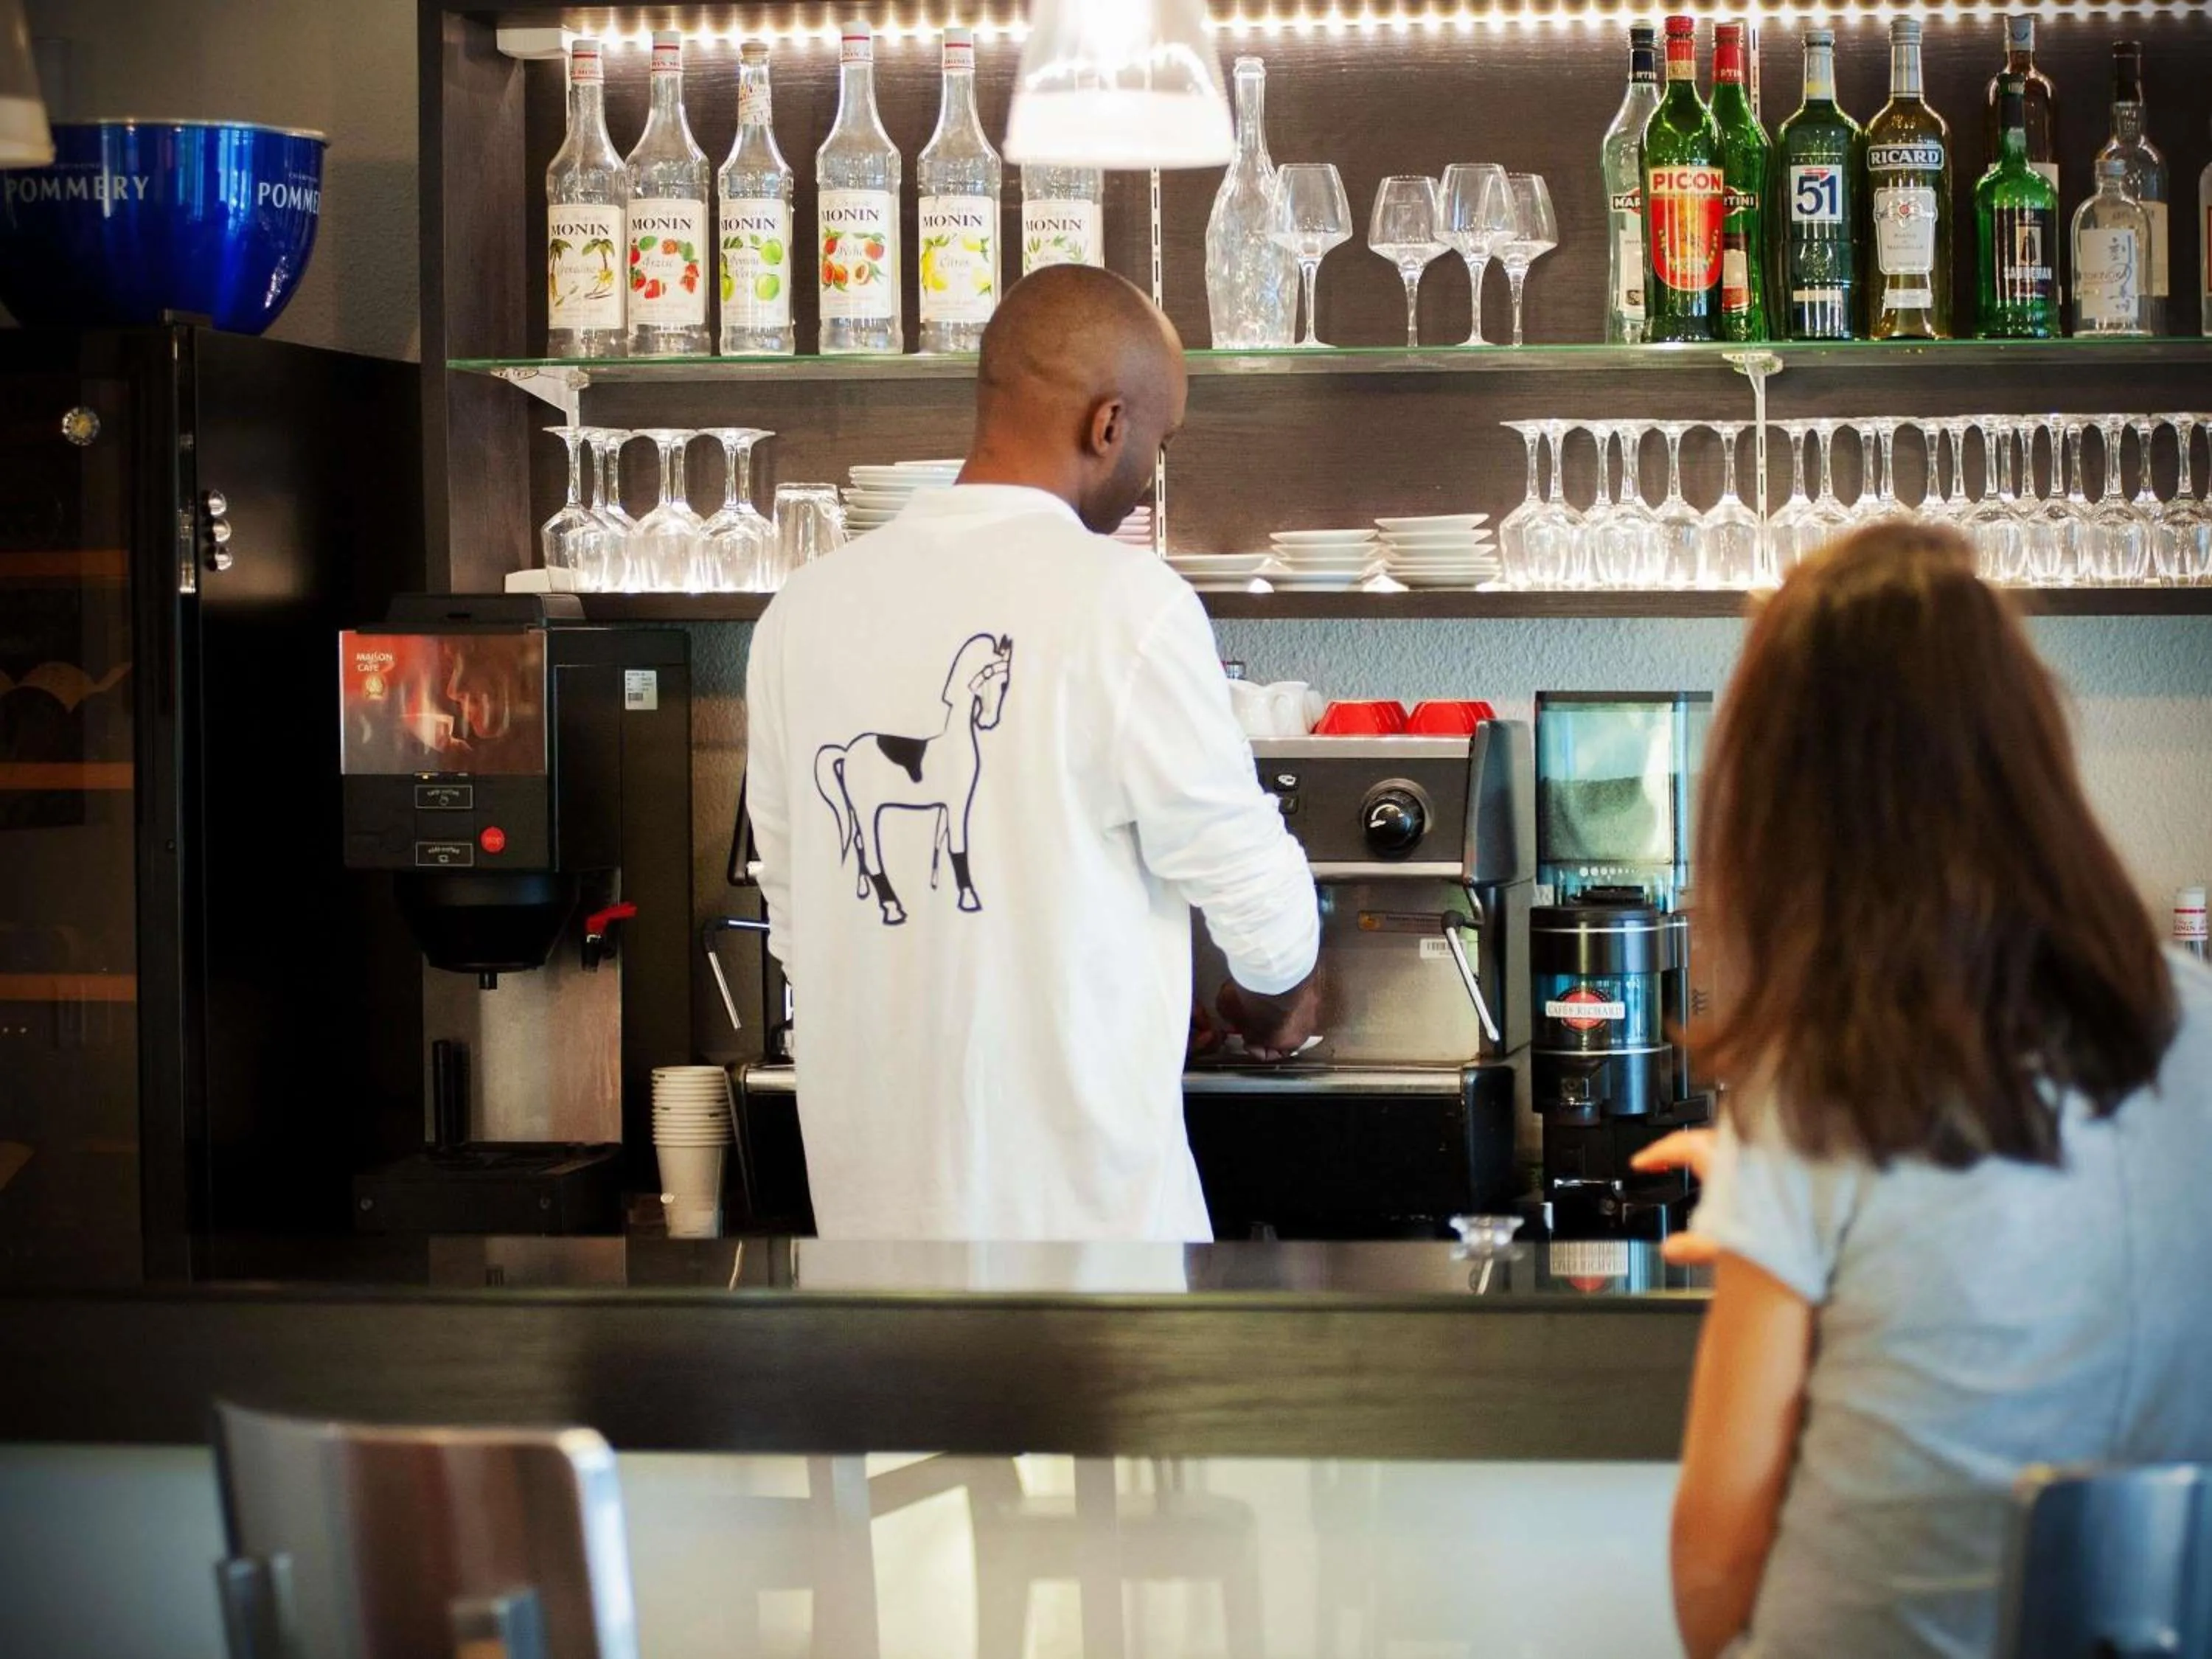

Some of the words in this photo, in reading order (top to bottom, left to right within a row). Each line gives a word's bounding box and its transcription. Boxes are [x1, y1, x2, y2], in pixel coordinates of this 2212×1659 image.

[1871, 150, 1939, 164] RICARD
[1652, 173, 1722, 190] PICON
[4, 176, 149, 203] POMMERY
[1796, 175, 1837, 215] 51
[821, 209, 879, 221] MONIN
[923, 215, 982, 226] MONIN
[552, 223, 609, 236] MONIN
[632, 218, 691, 230] MONIN
[720, 218, 776, 230] MONIN
[1026, 219, 1082, 232] MONIN
